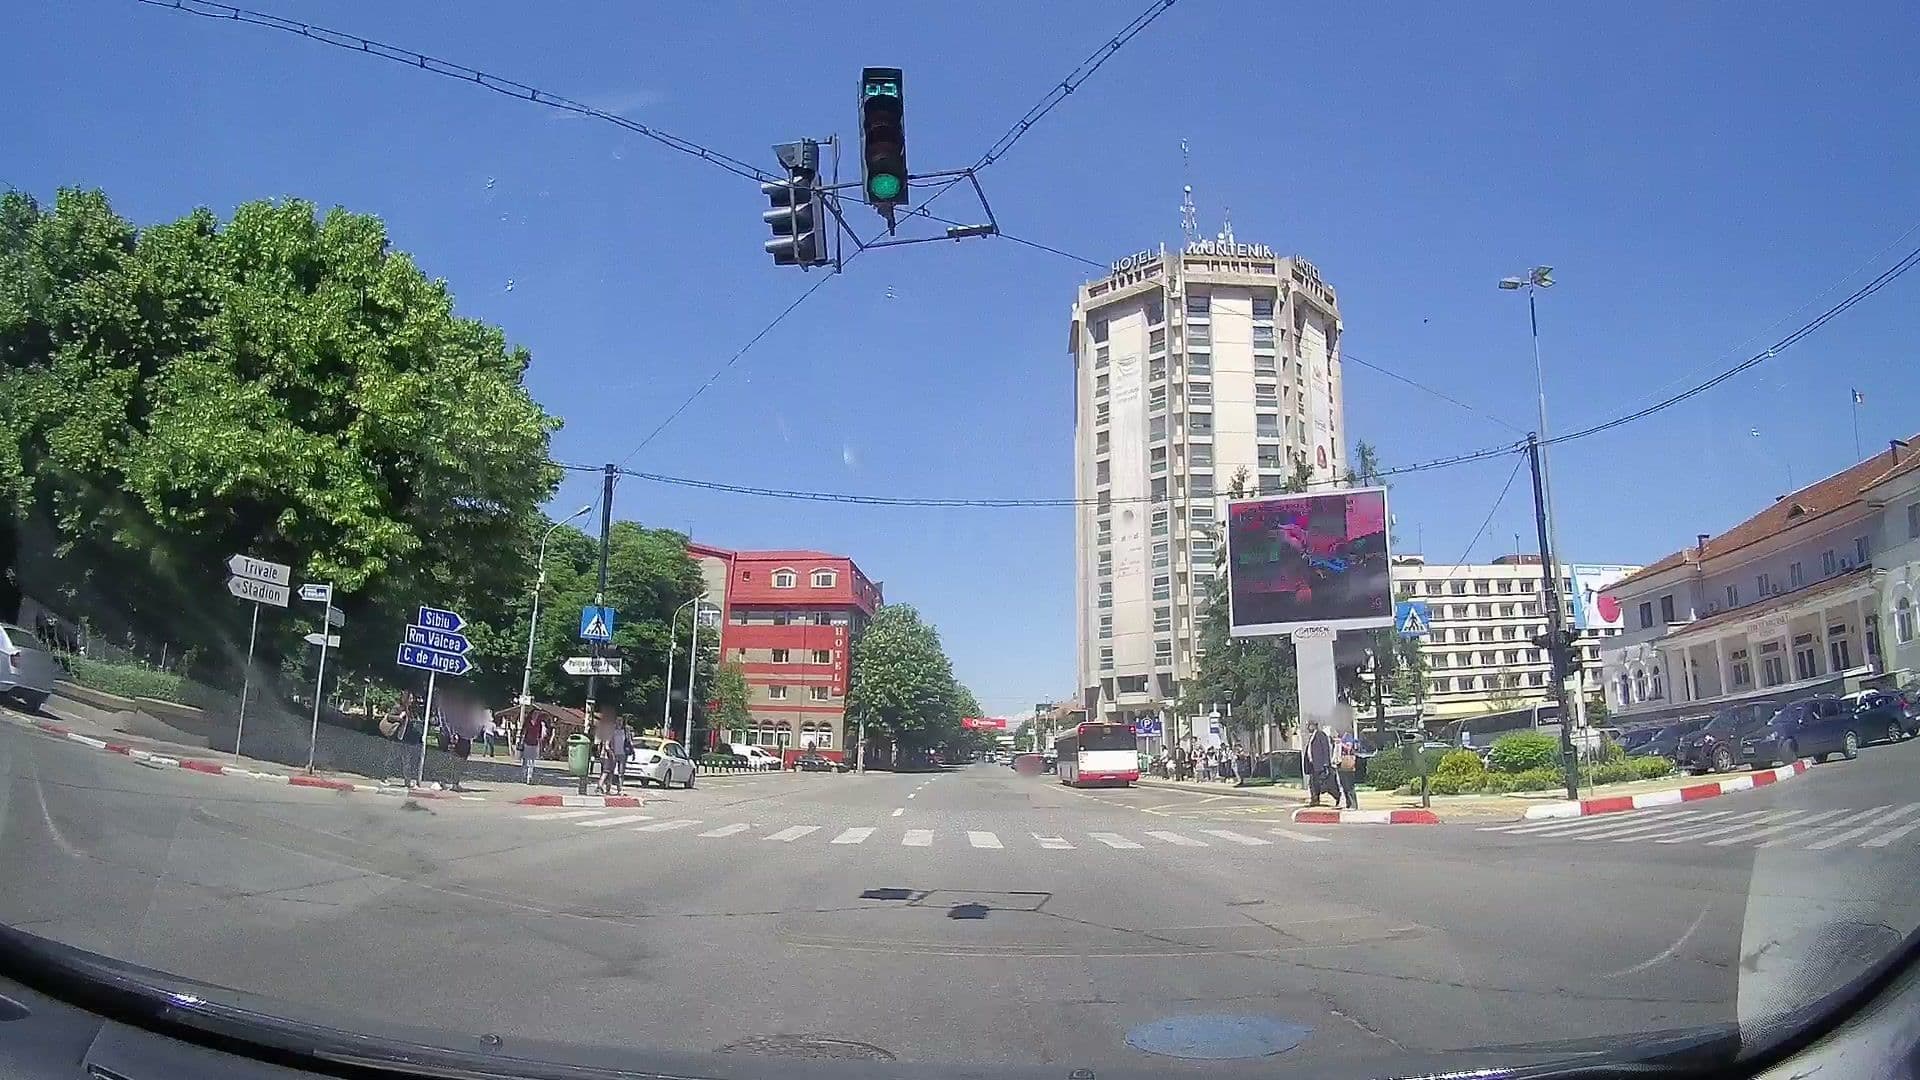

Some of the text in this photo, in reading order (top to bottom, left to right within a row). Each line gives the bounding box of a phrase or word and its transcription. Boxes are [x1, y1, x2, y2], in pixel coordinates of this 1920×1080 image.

[1111, 248, 1156, 274] HOTEL
[244, 559, 279, 579] Trivale
[242, 580, 281, 601] Stadion
[425, 611, 450, 629] Sibiu
[404, 647, 414, 662] C.
[416, 650, 428, 664] de
[834, 626, 843, 682] HOTEL
